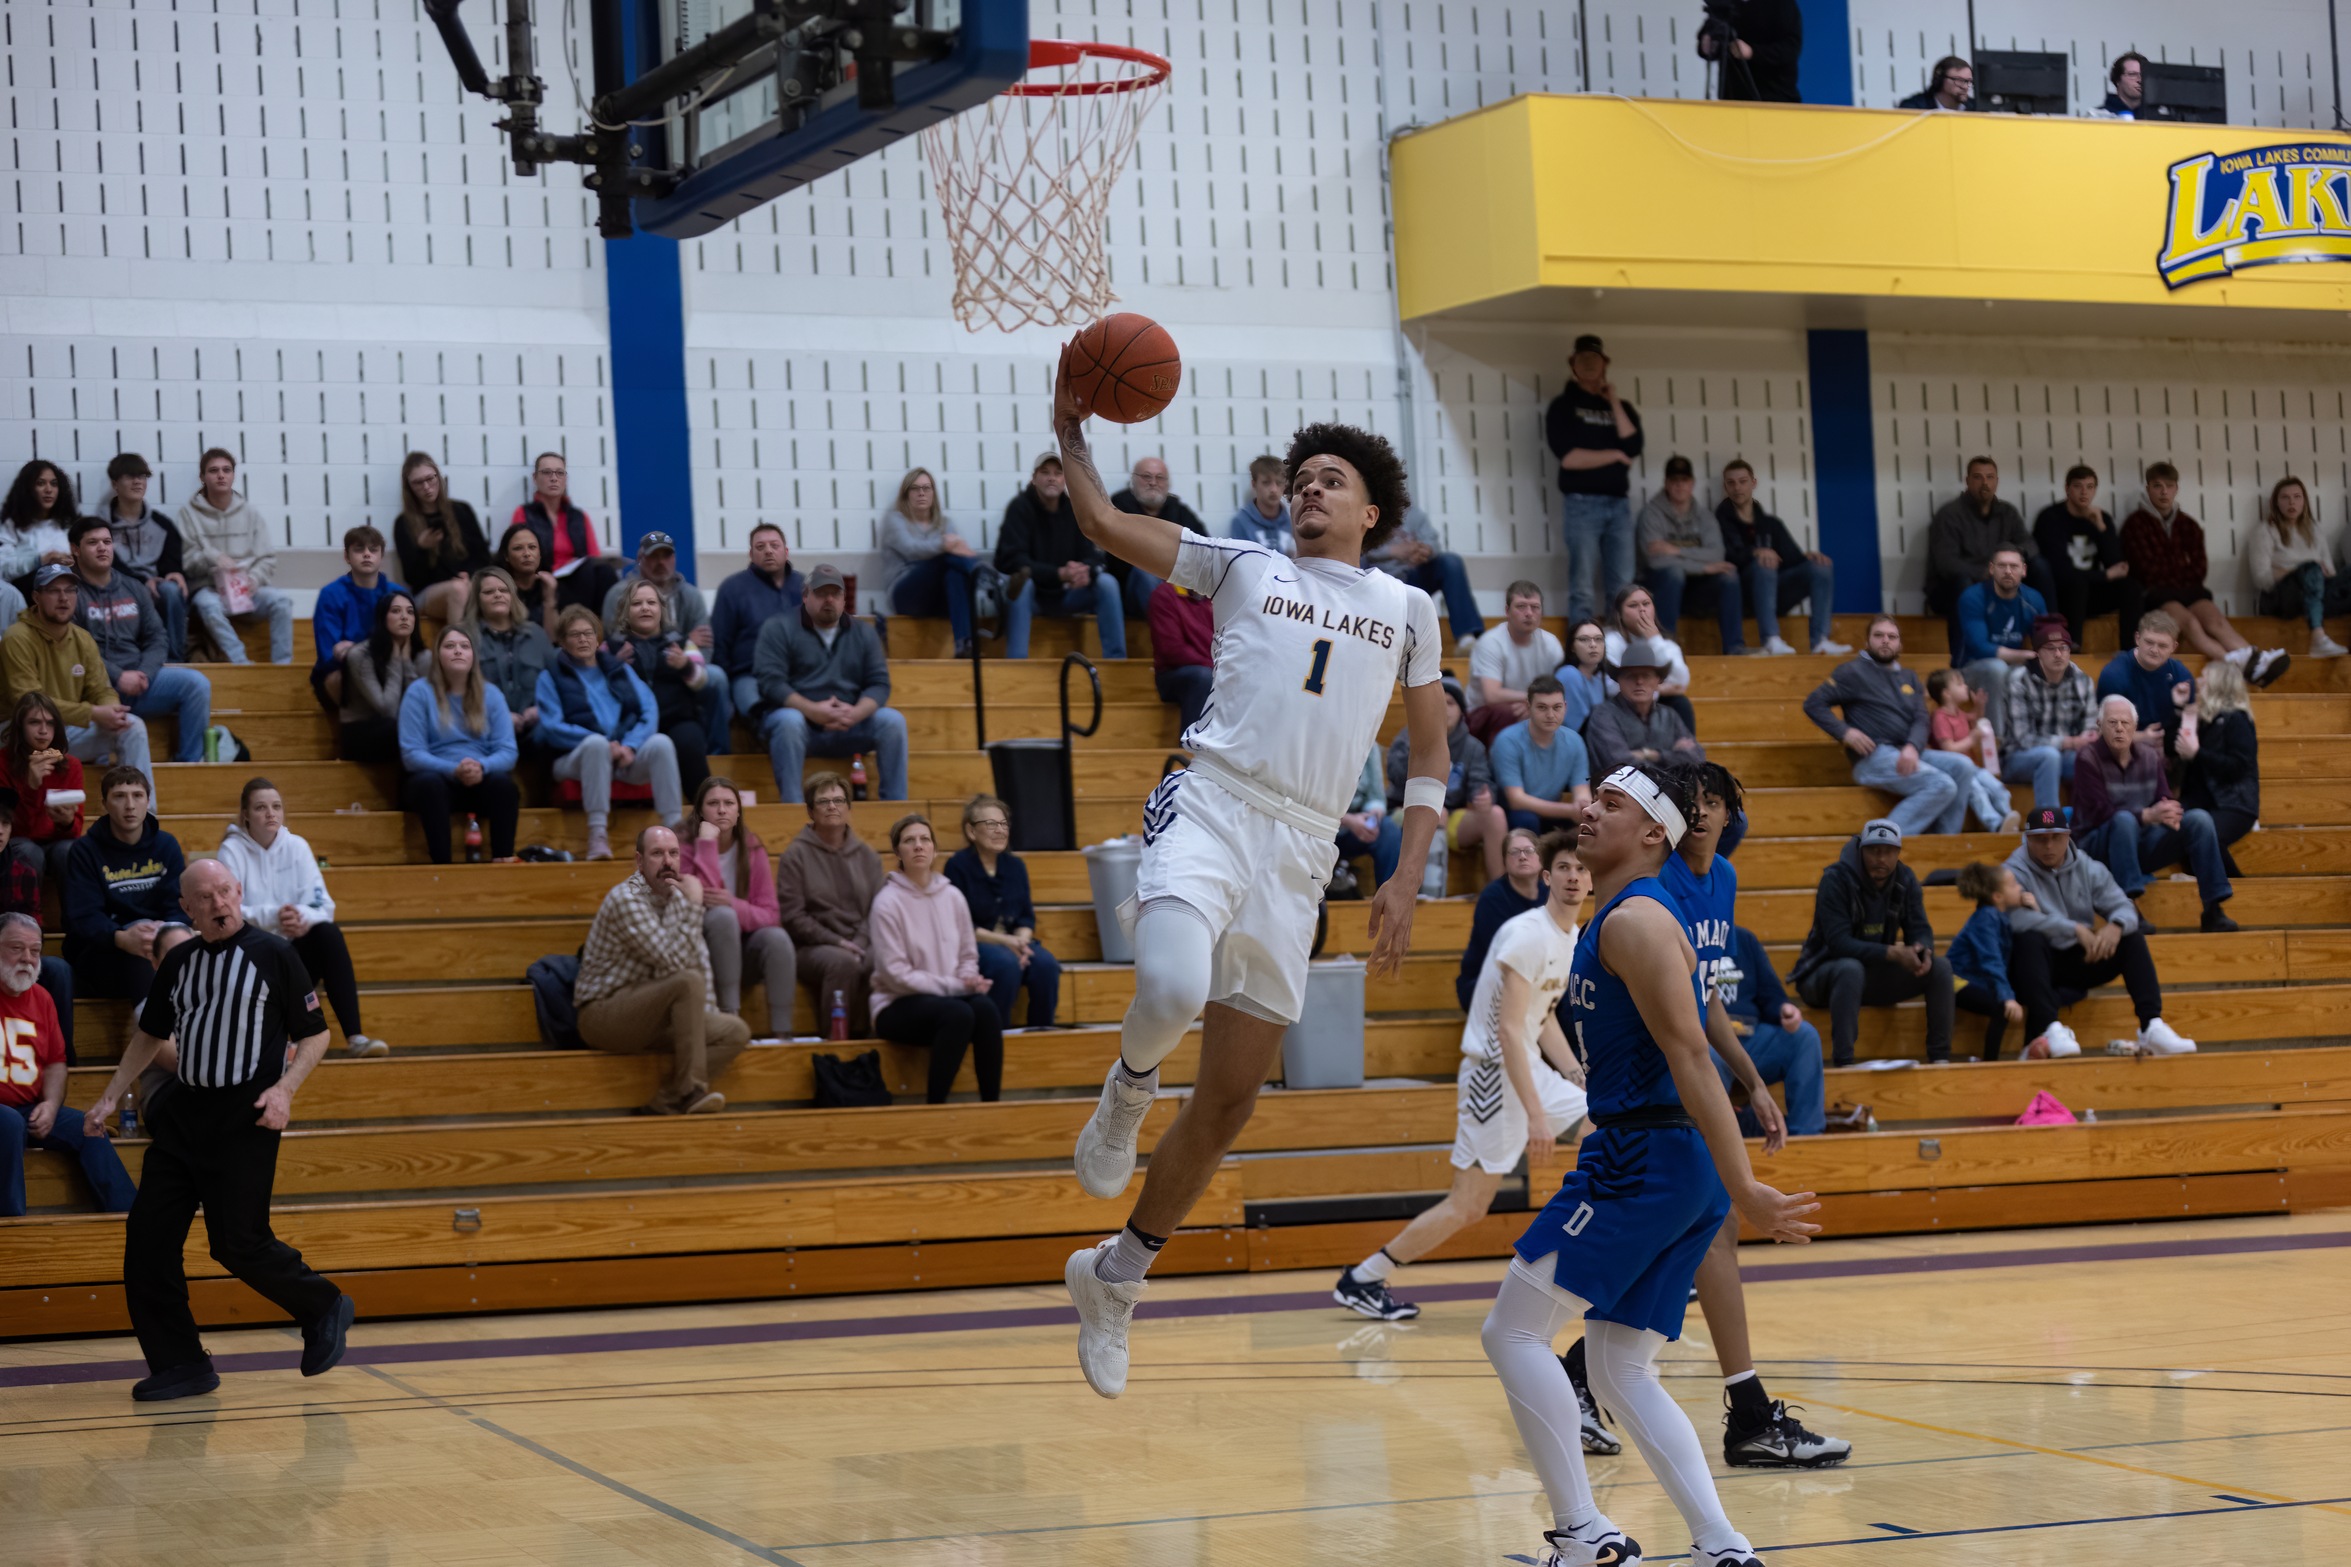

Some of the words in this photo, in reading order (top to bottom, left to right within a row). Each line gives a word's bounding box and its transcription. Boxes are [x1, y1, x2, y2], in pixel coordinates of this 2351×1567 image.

[2220, 154, 2254, 174] IOWA
[2256, 148, 2300, 166] LAKES
[1262, 595, 1315, 625] IOWA
[1322, 609, 1395, 649] LAKES
[1302, 637, 1334, 697] 1
[1561, 1200, 1595, 1237] D
